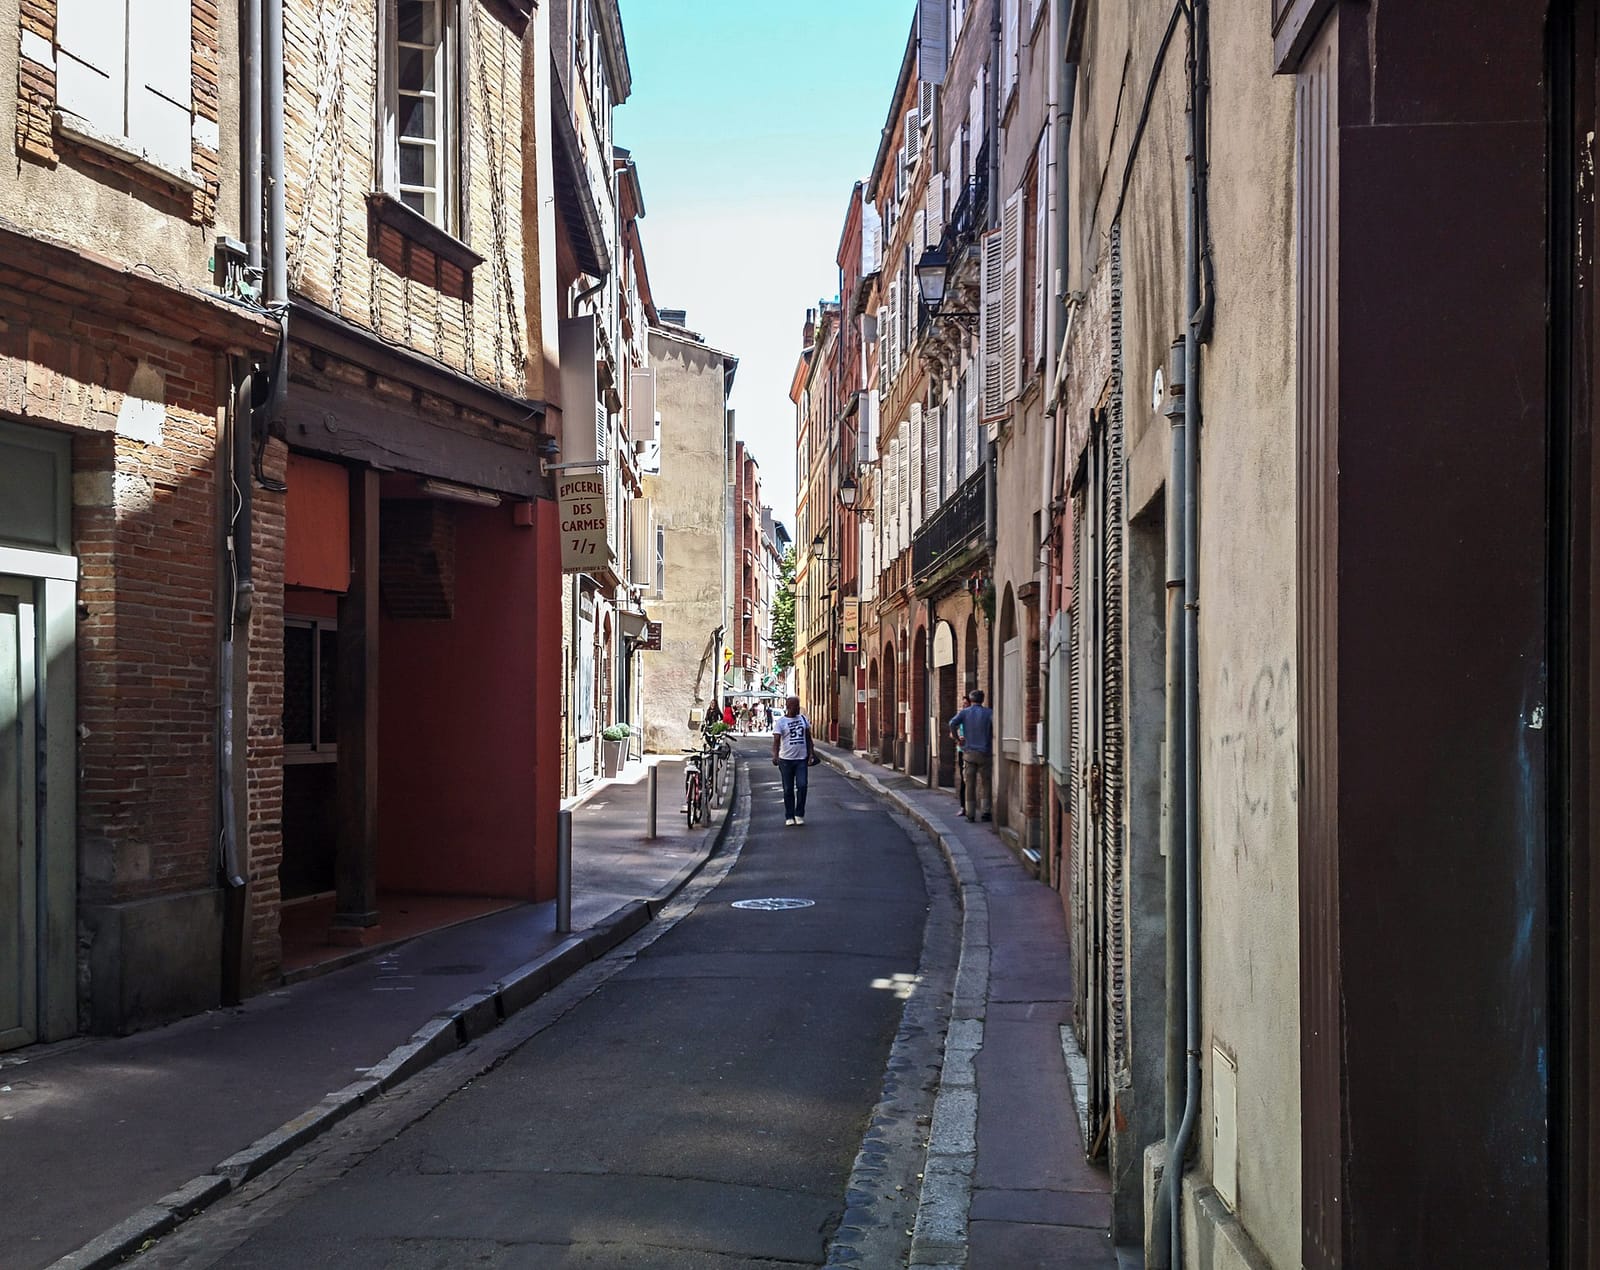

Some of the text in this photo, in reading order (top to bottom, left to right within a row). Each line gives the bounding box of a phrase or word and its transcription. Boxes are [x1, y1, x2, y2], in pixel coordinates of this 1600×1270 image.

[560, 481, 603, 497] EPICERIE
[573, 503, 592, 515] DES
[561, 518, 605, 532] CARMES
[572, 538, 596, 555] 7/7
